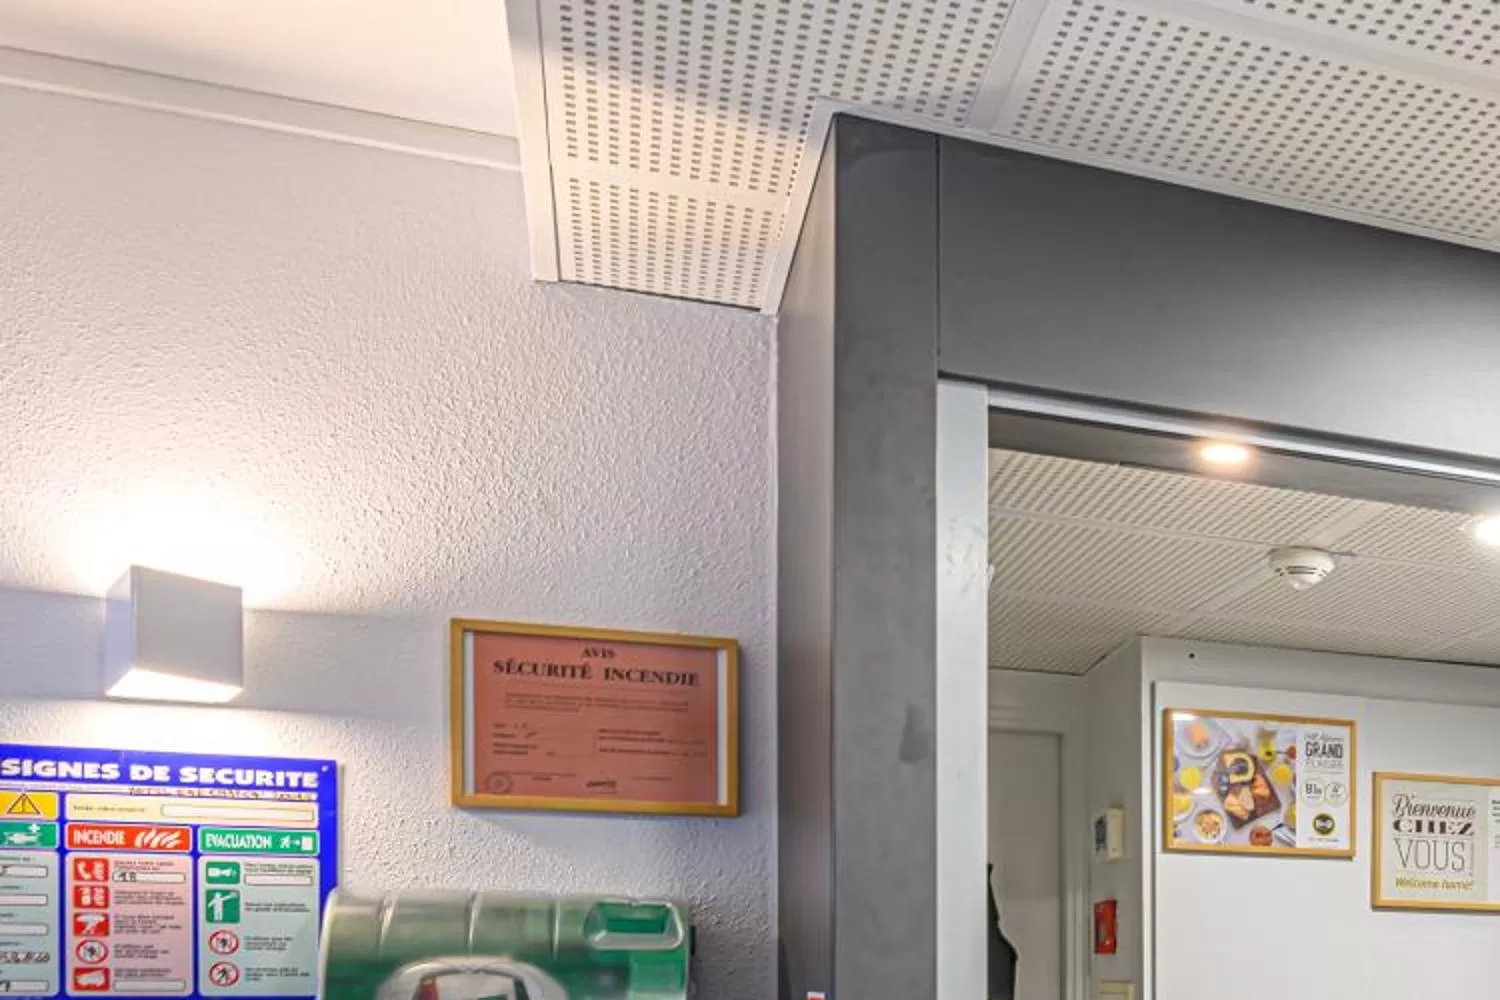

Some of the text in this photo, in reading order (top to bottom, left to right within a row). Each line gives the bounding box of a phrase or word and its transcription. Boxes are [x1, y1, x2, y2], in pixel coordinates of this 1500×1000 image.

[581, 647, 616, 660] AVIS
[493, 658, 700, 687] SÉCURITÉ INCENDIE
[1305, 742, 1343, 759] GRAND
[1, 758, 319, 789] SIGNES DE SECURITE
[1392, 793, 1476, 818] Bienvenue
[1393, 819, 1475, 836] CHEZ
[73, 829, 125, 845] INCENDIE
[205, 831, 272, 849] EVACUATION
